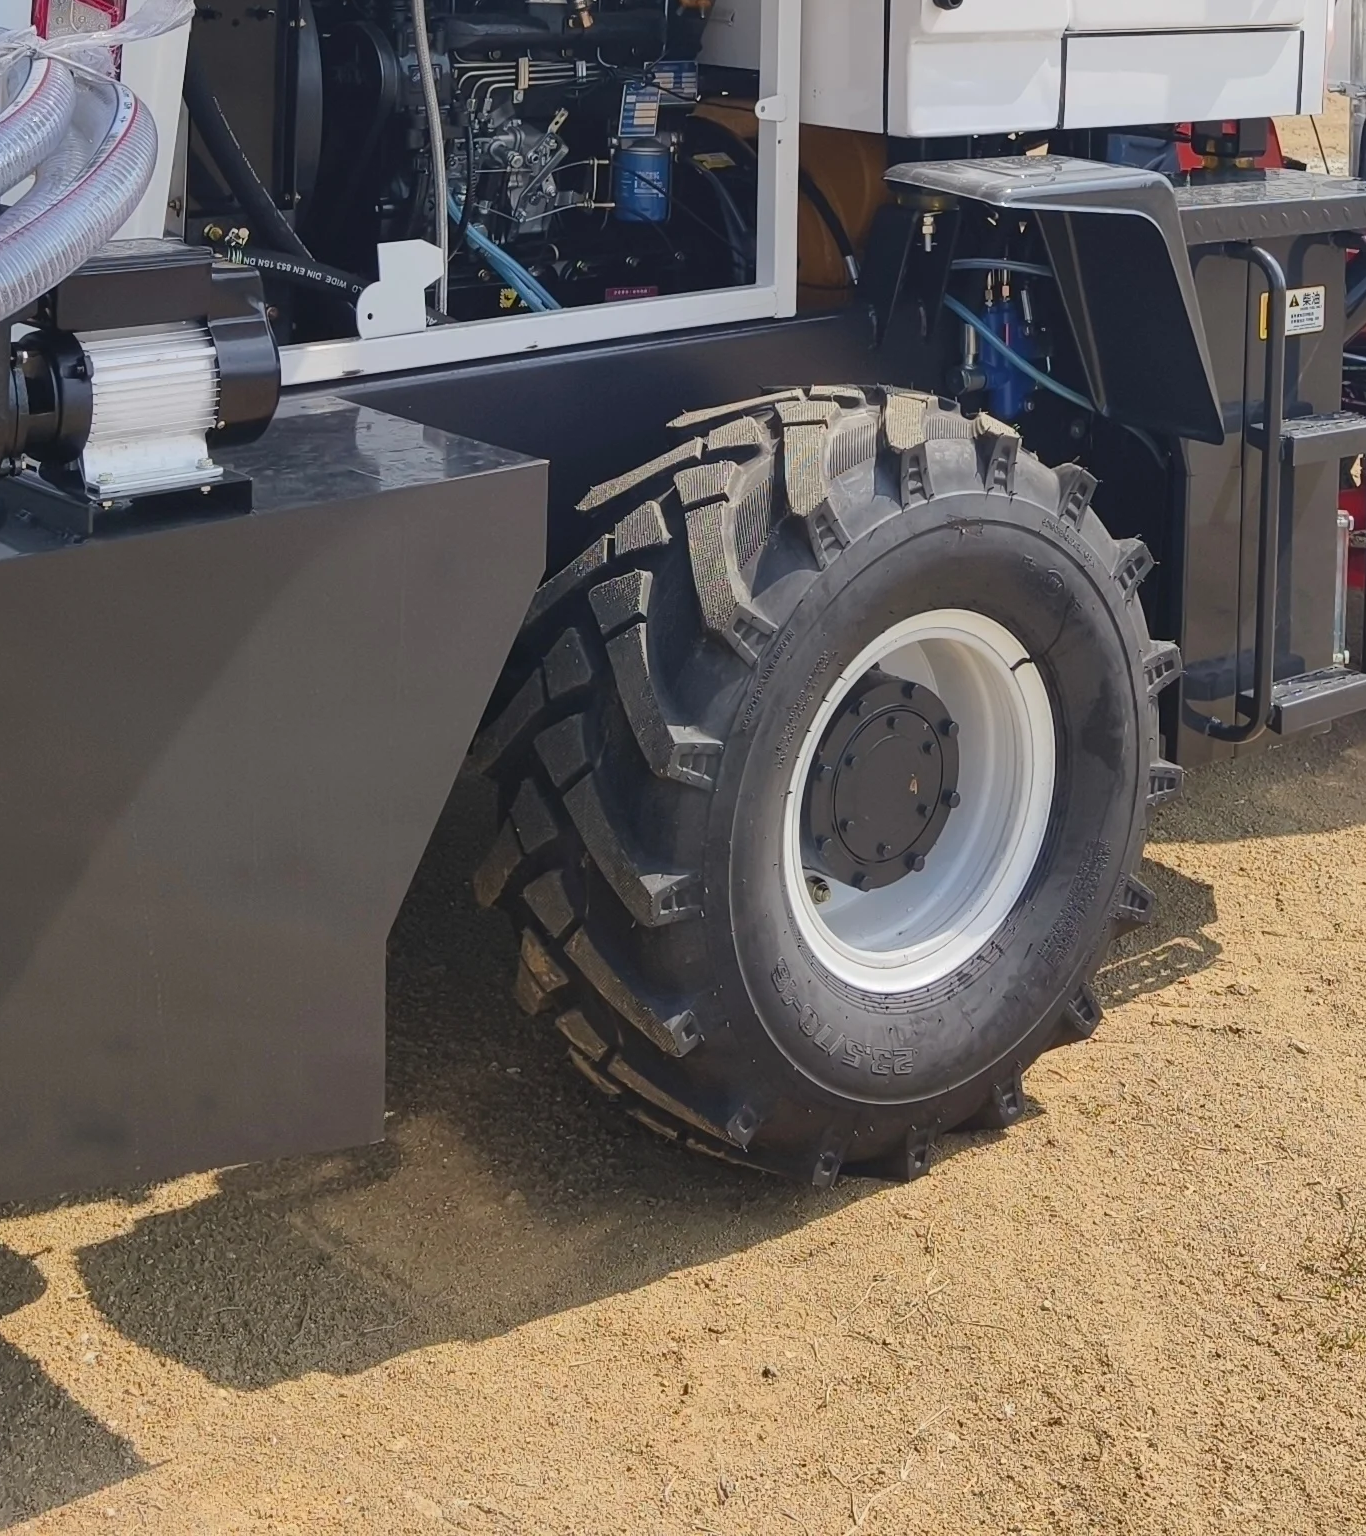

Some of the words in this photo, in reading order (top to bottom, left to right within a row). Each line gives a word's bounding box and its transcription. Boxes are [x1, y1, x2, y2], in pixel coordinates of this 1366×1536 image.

[257, 257, 274, 269] 1SN
[276, 261, 291, 272] 853
[292, 264, 306, 276] EN
[306, 268, 323, 281] DIN
[325, 274, 348, 289] WIDE
[1302, 291, 1320, 307] 柴油
